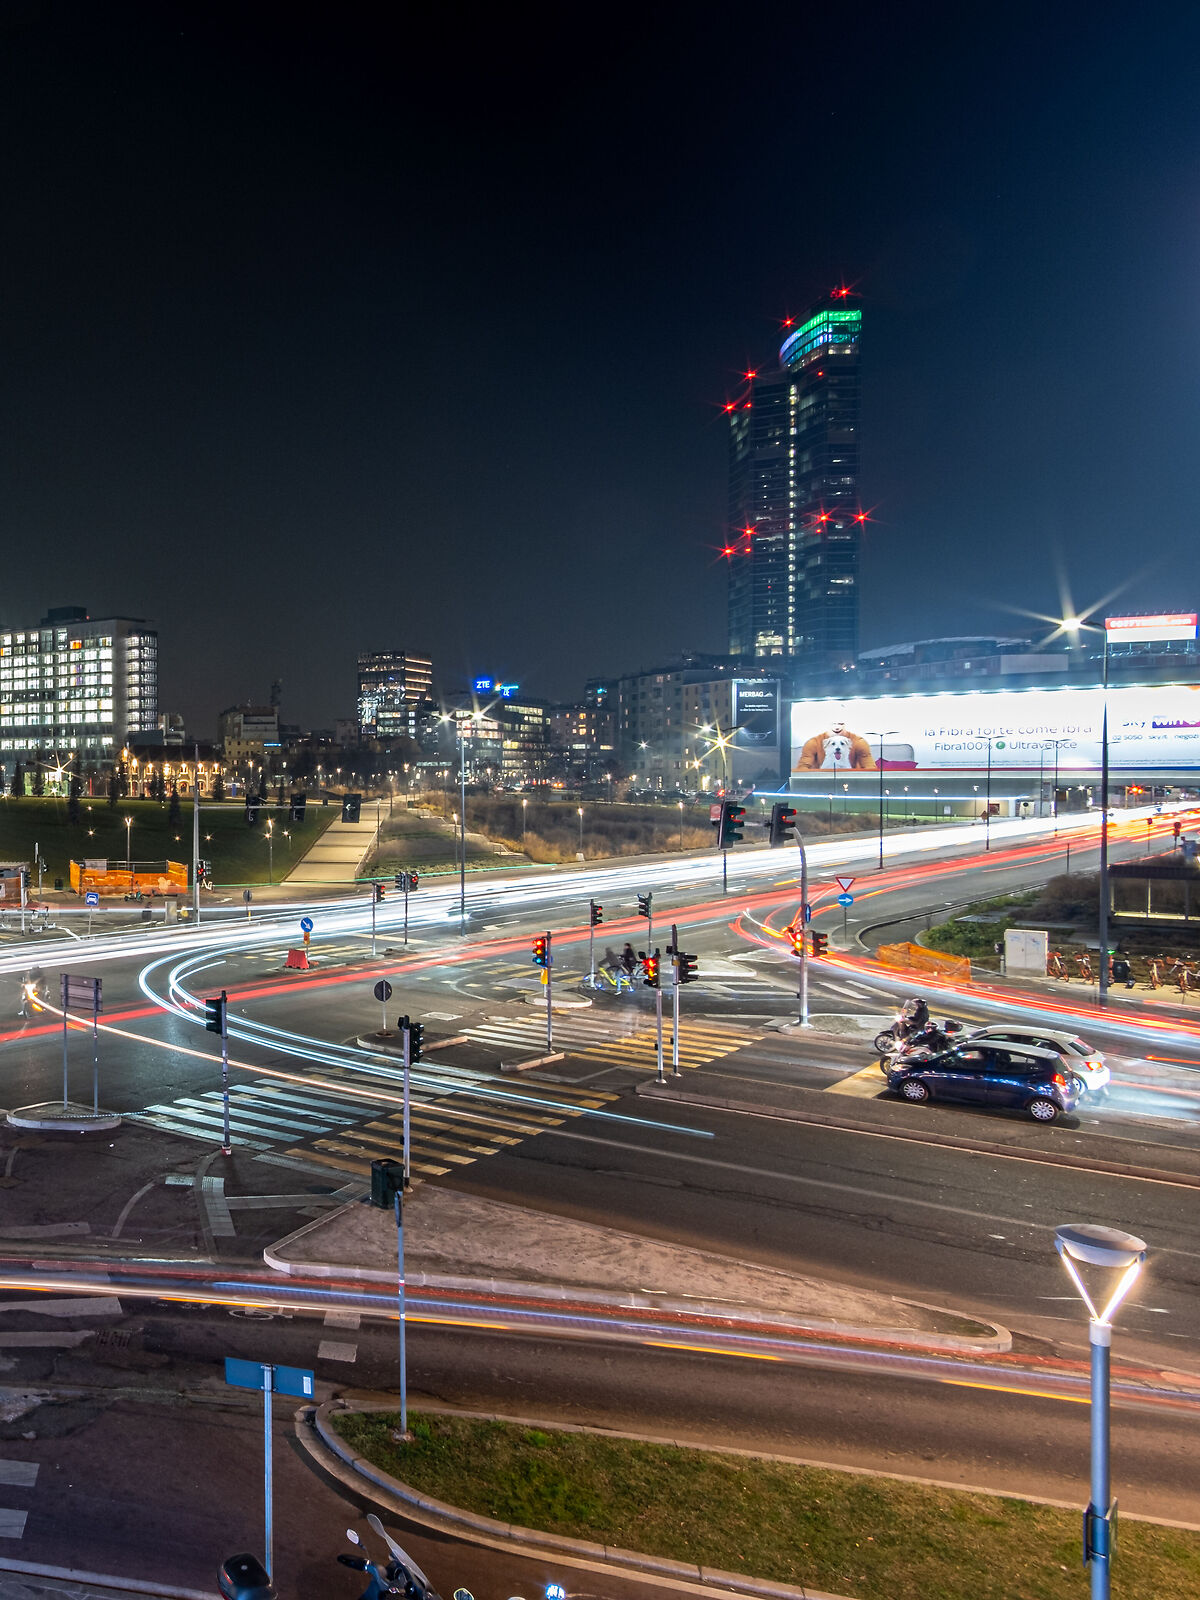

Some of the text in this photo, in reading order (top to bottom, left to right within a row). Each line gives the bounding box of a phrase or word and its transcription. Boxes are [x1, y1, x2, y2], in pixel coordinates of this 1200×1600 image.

[476, 680, 490, 689] ZTE
[934, 740, 1078, 751] Fibra100% Ultraveloce
